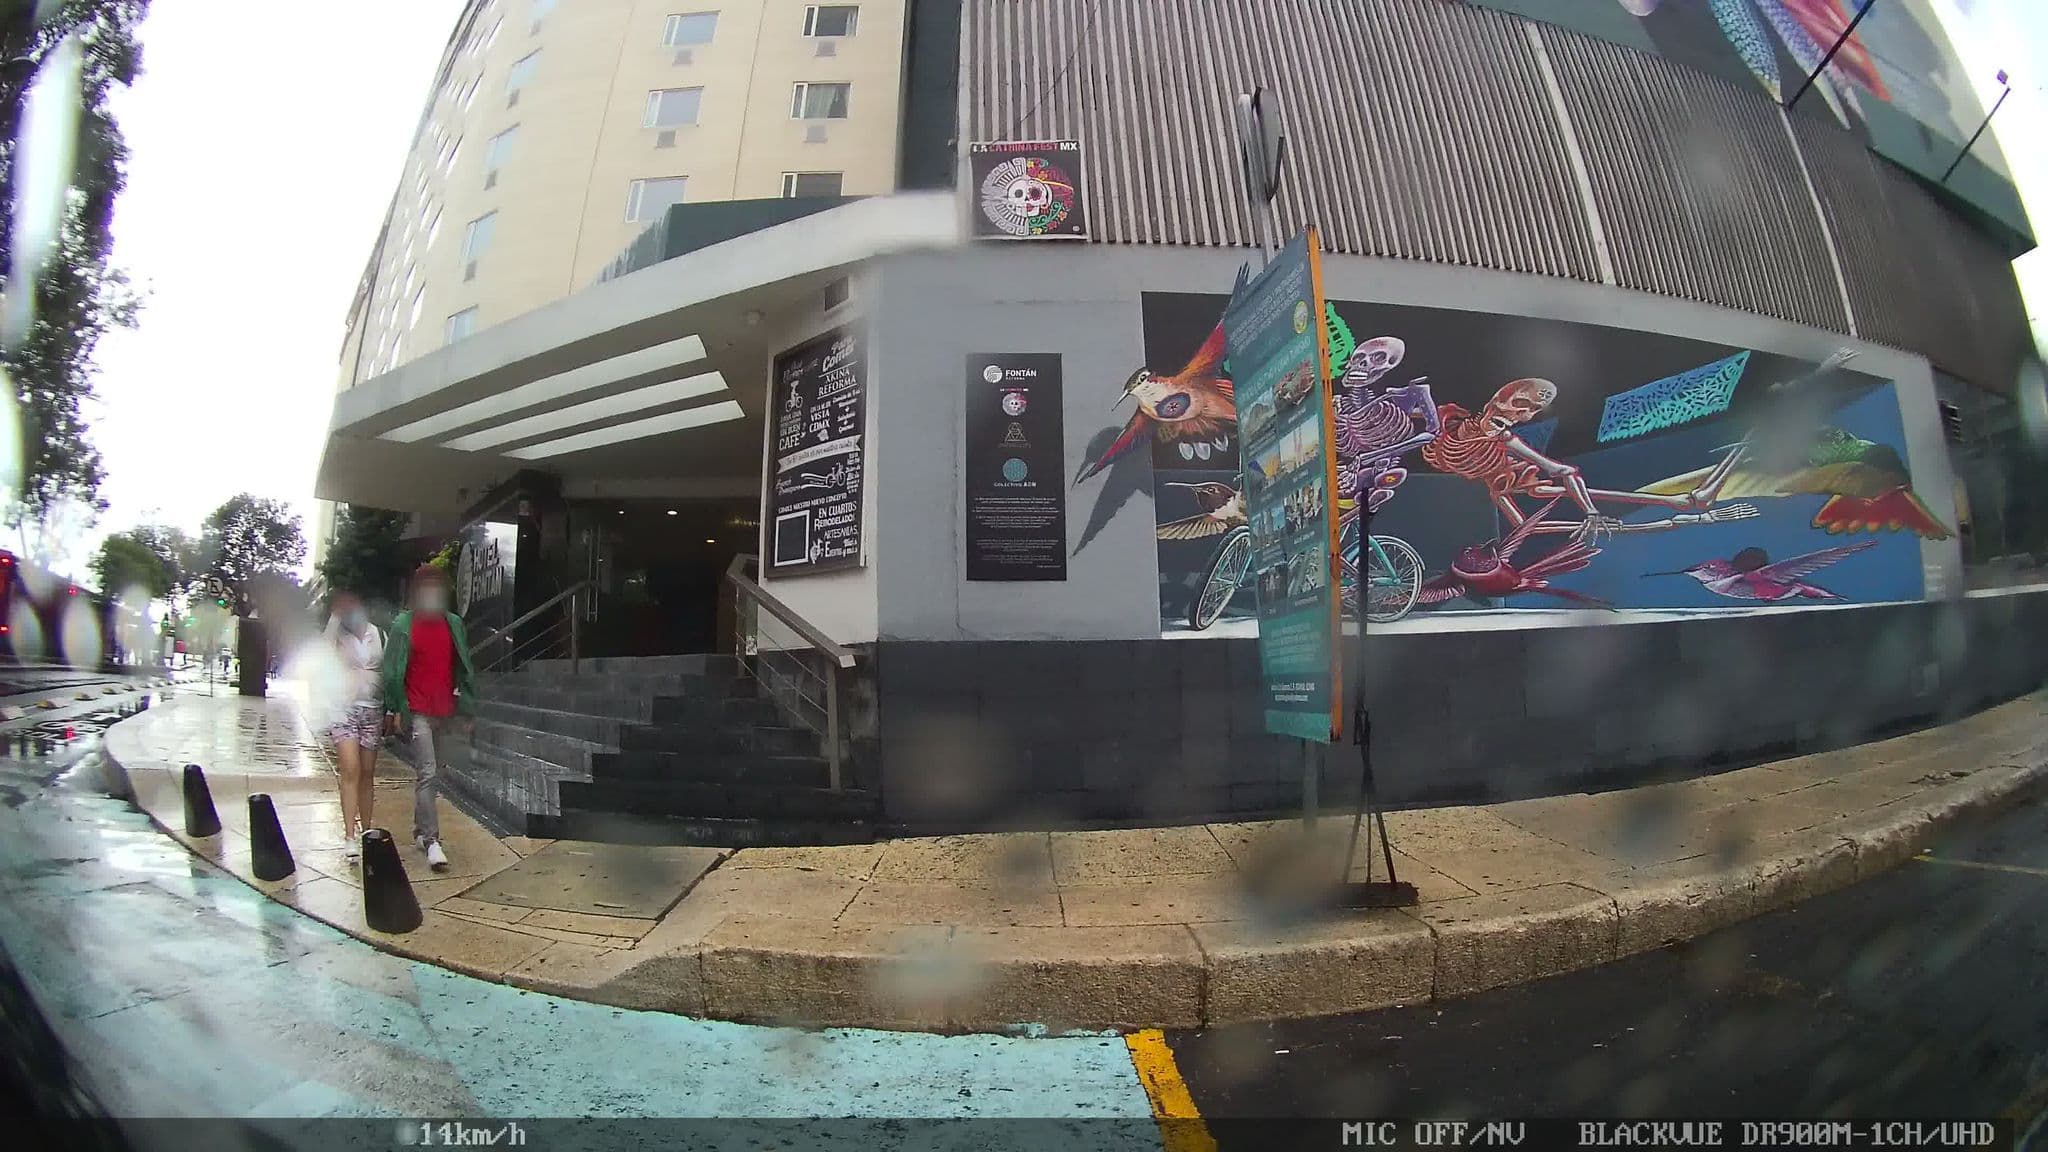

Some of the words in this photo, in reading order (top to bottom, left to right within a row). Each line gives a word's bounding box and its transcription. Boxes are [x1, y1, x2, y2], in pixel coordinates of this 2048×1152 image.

[989, 144, 1032, 152] CATRINA
[1034, 143, 1058, 151] FEST
[1060, 142, 1077, 151] MX
[1005, 368, 1037, 377] FONTÁN
[818, 376, 856, 396] REFORMA
[810, 409, 830, 422] VISTA
[809, 419, 830, 433] CDMX
[818, 507, 827, 518] EN
[828, 501, 857, 517] CUARTOS
